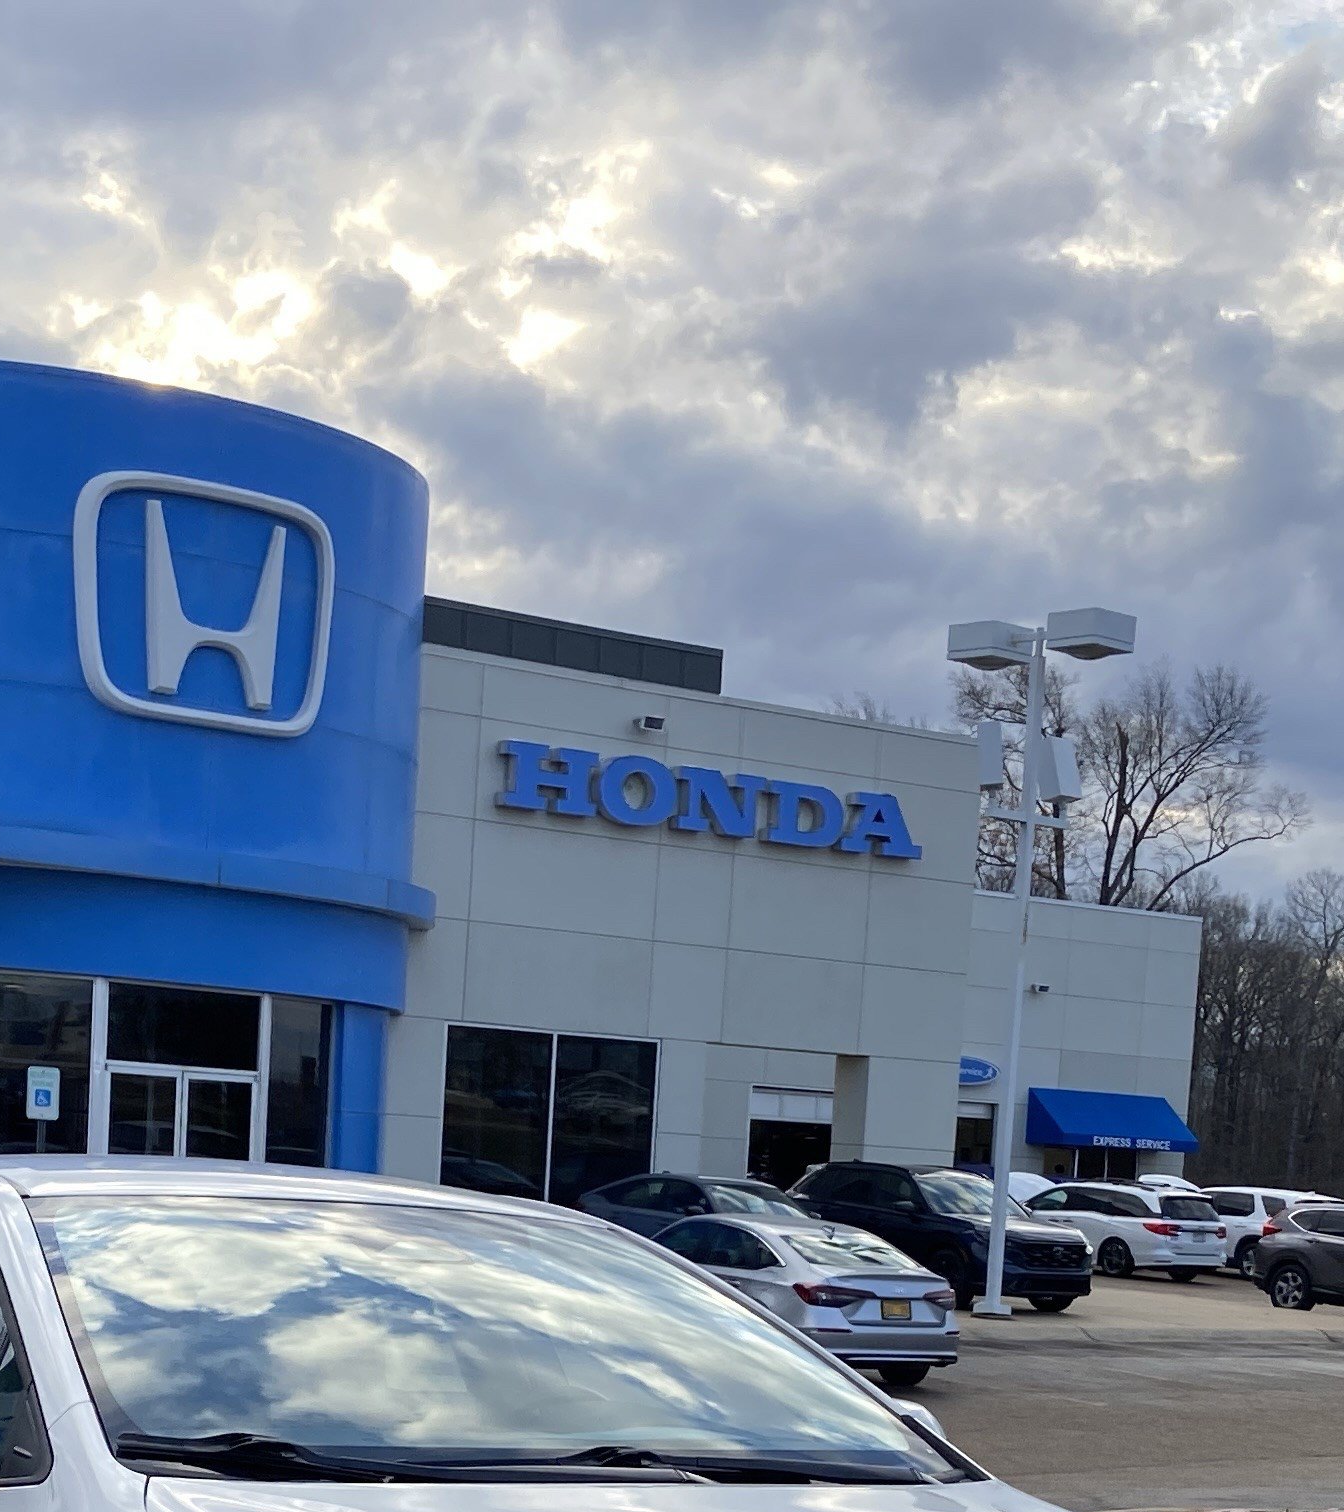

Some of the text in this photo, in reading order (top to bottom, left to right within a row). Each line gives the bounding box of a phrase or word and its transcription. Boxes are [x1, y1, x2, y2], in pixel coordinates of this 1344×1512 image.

[497, 739, 923, 860] HONDA
[1093, 1135, 1171, 1151] EXPRESS SERVICE
